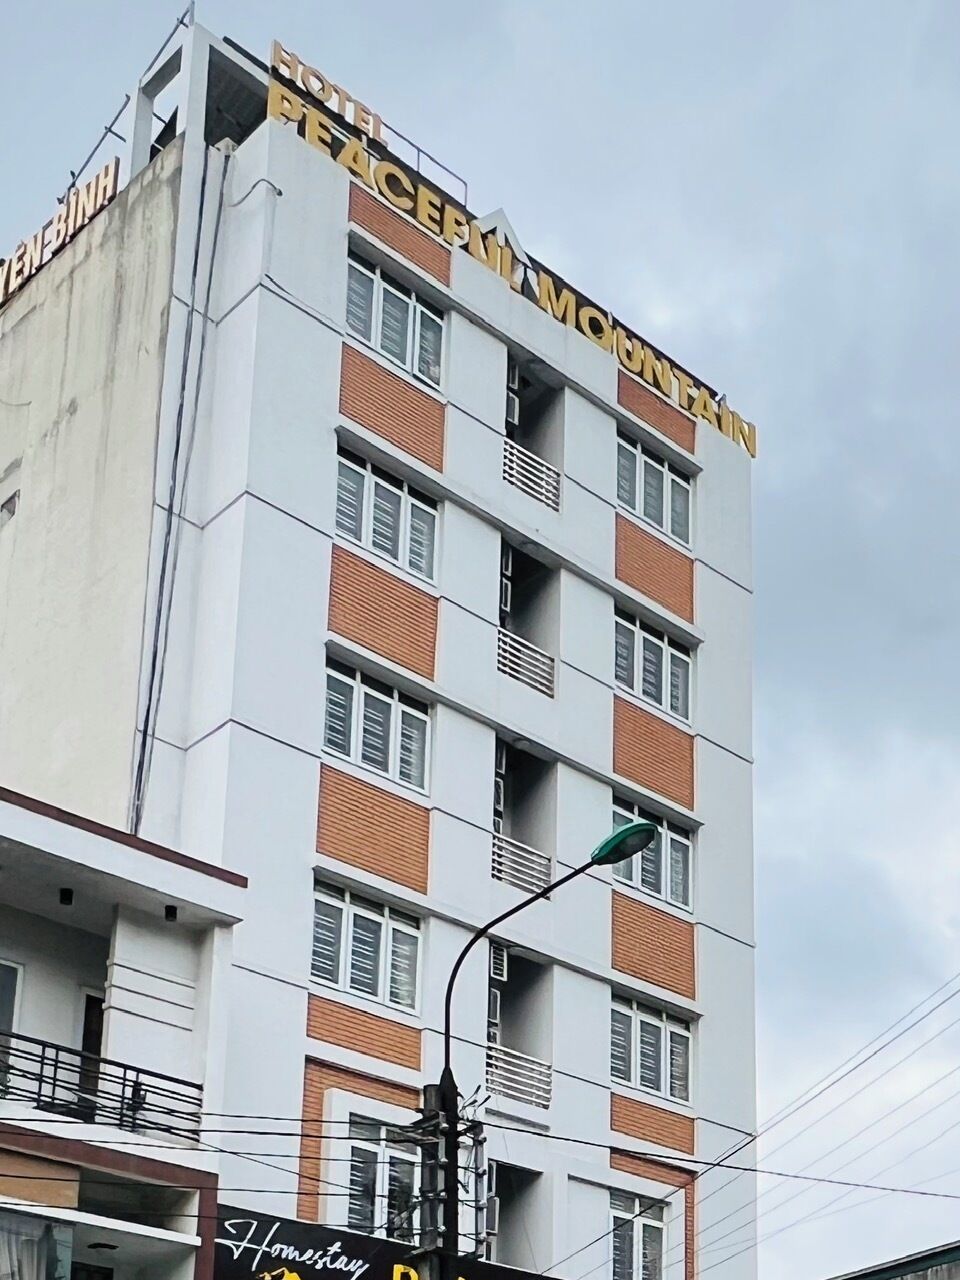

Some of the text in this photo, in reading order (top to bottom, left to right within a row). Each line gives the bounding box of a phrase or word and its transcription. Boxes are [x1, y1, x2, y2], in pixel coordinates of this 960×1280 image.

[270, 39, 388, 148] HOTEL
[267, 77, 757, 458] PEACEFUL MOUNTAIN
